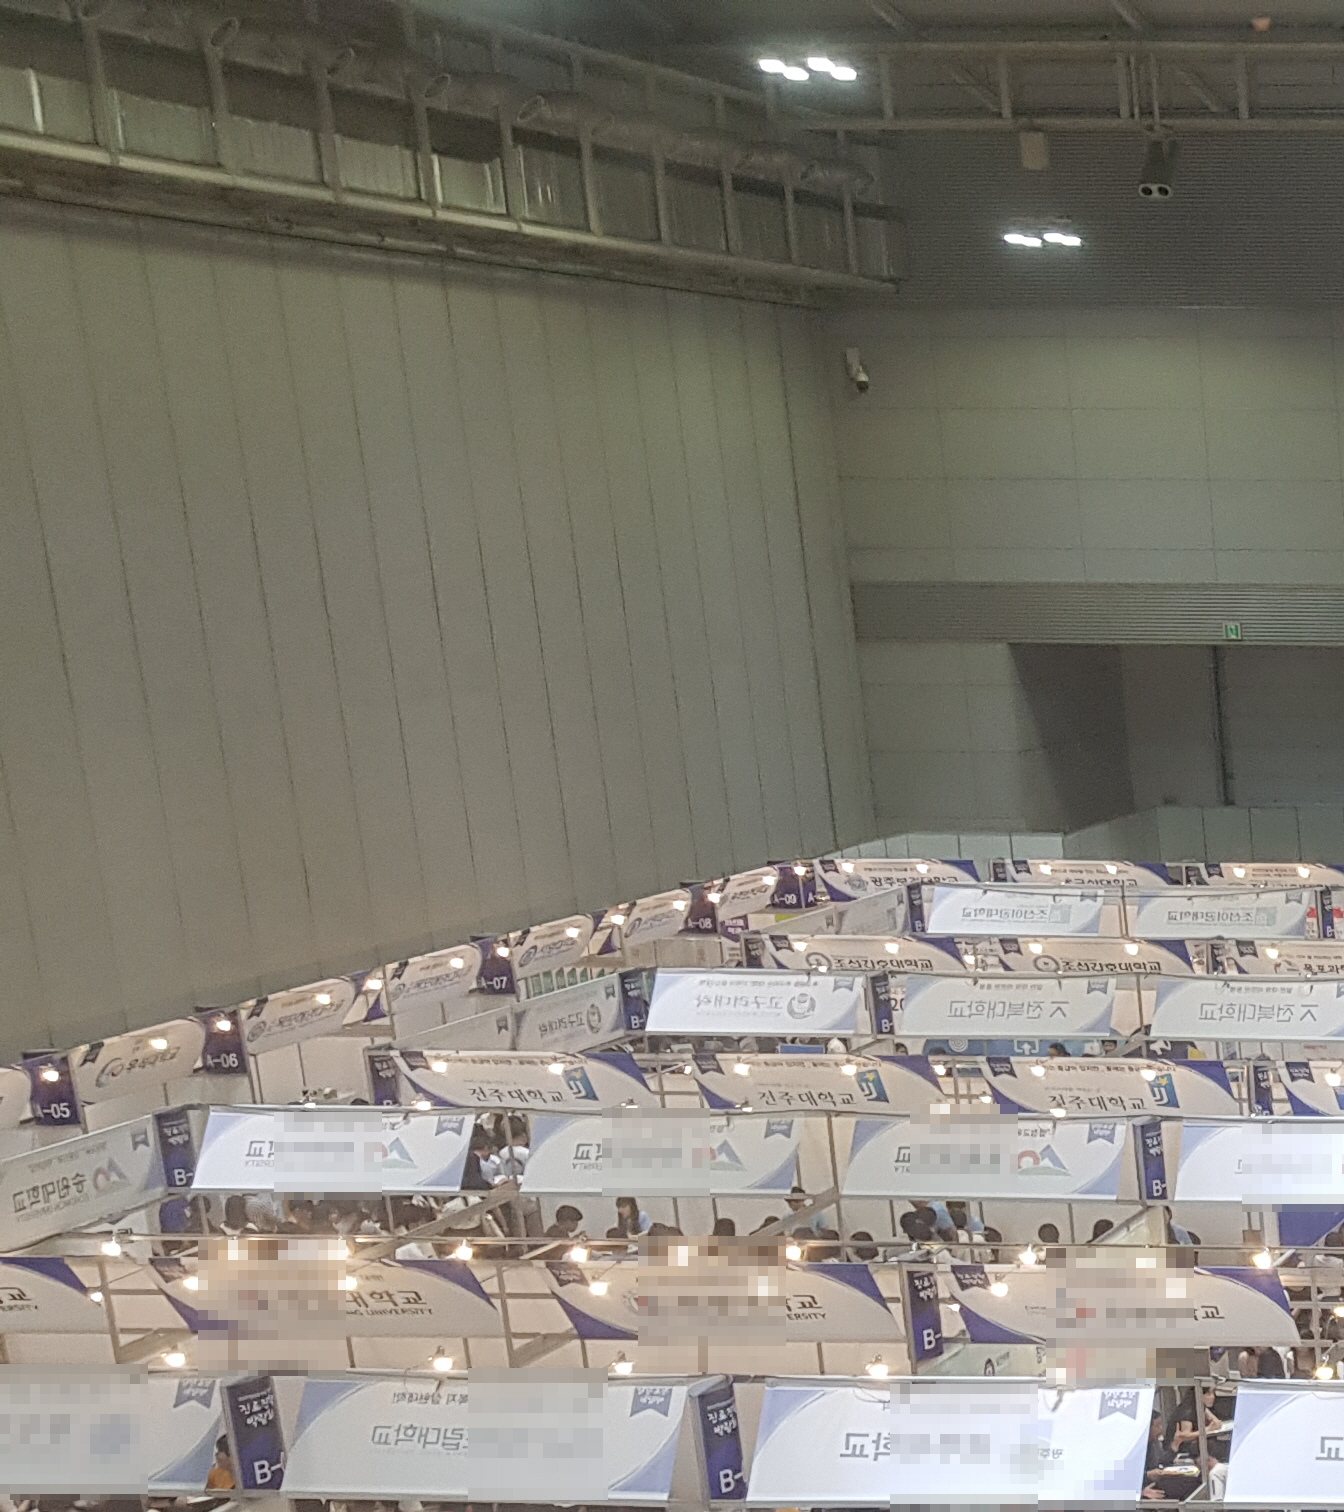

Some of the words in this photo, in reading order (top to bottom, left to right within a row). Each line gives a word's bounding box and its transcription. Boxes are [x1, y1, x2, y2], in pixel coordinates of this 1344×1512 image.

[469, 1086, 564, 1104] 전주대학교
[758, 1089, 857, 1107] 전주대학교
[1048, 1093, 1148, 1112] 전주대학교
